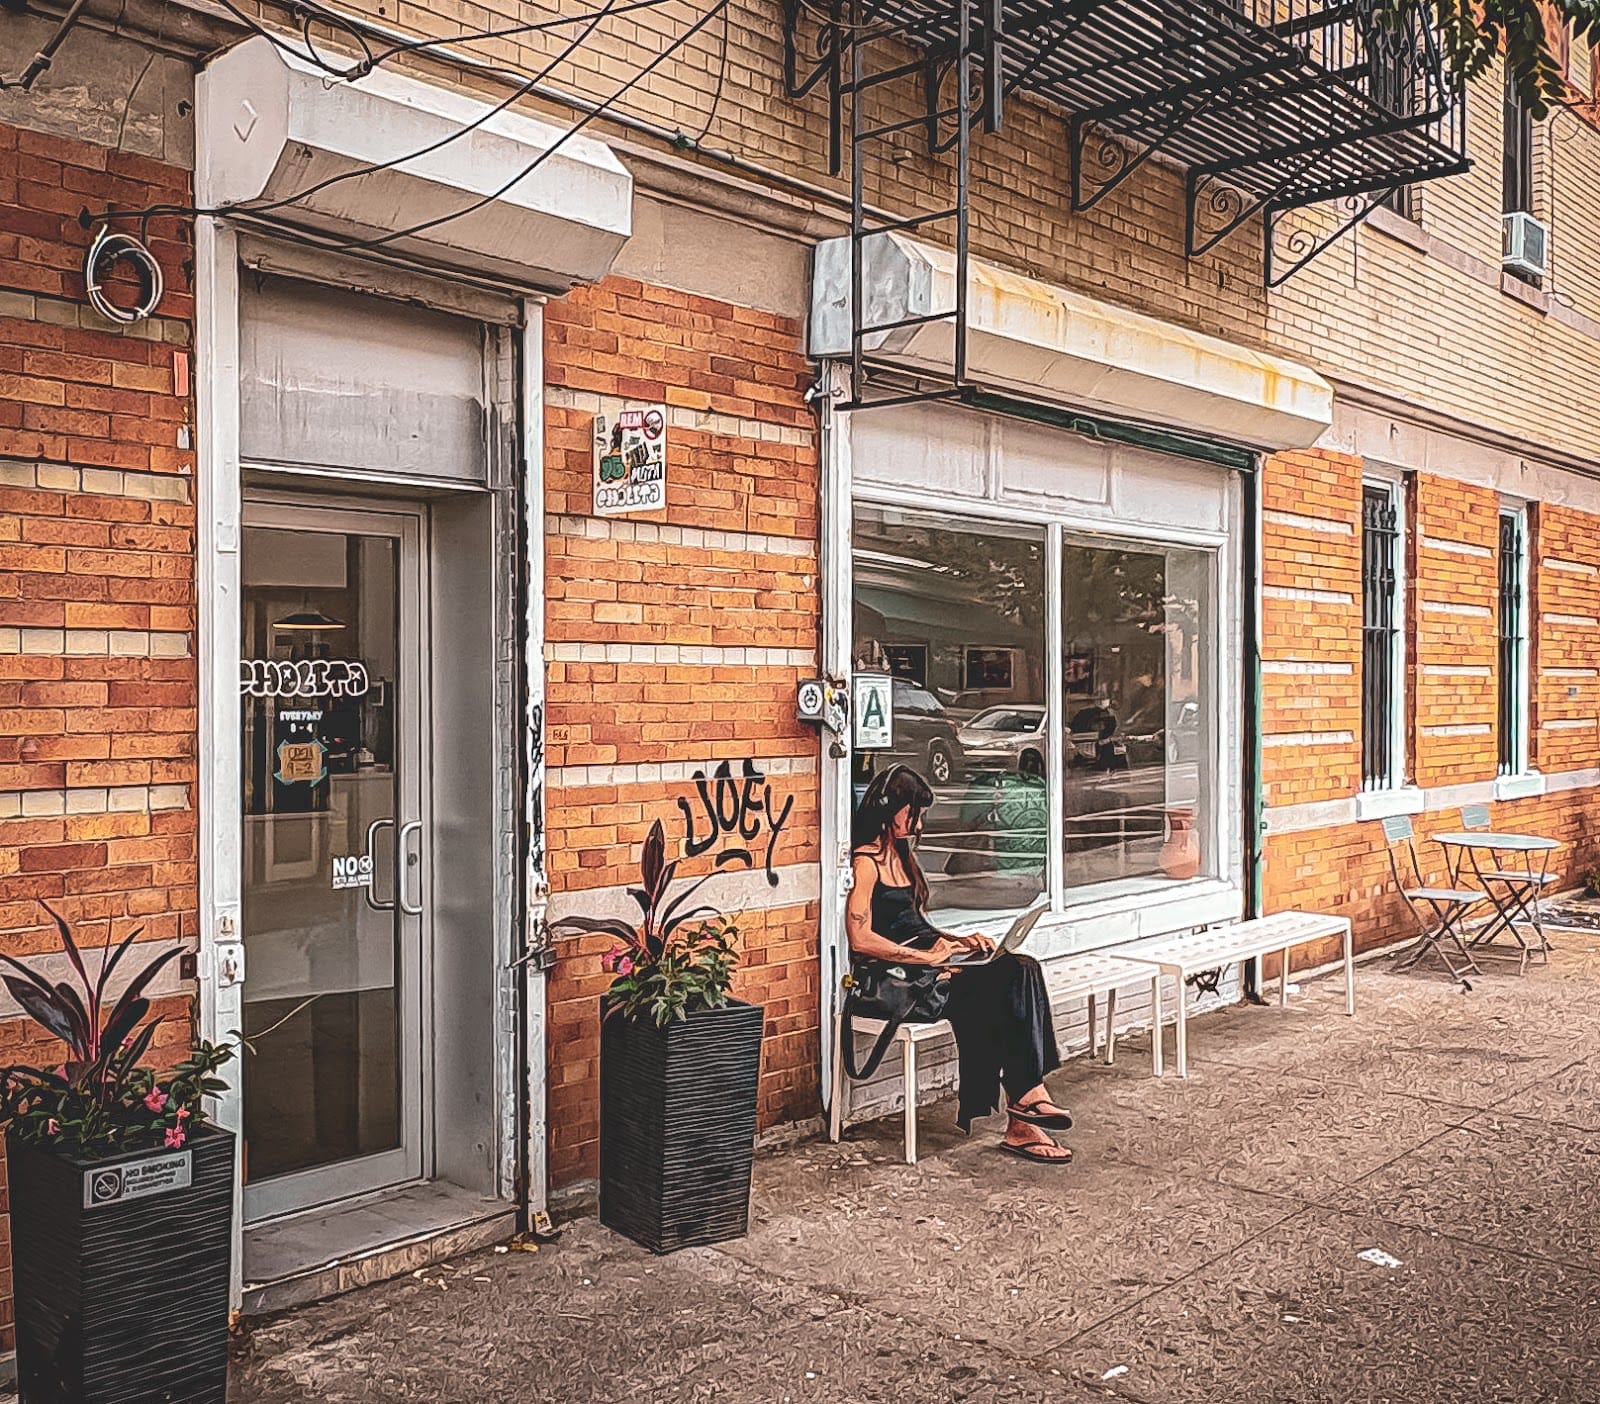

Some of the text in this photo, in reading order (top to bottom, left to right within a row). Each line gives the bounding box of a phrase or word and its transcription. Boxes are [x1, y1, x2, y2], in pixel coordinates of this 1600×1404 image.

[863, 686, 885, 728] A
[333, 857, 358, 877] NO
[126, 1168, 140, 1178] NO
[141, 1158, 186, 1176] SMOKING
